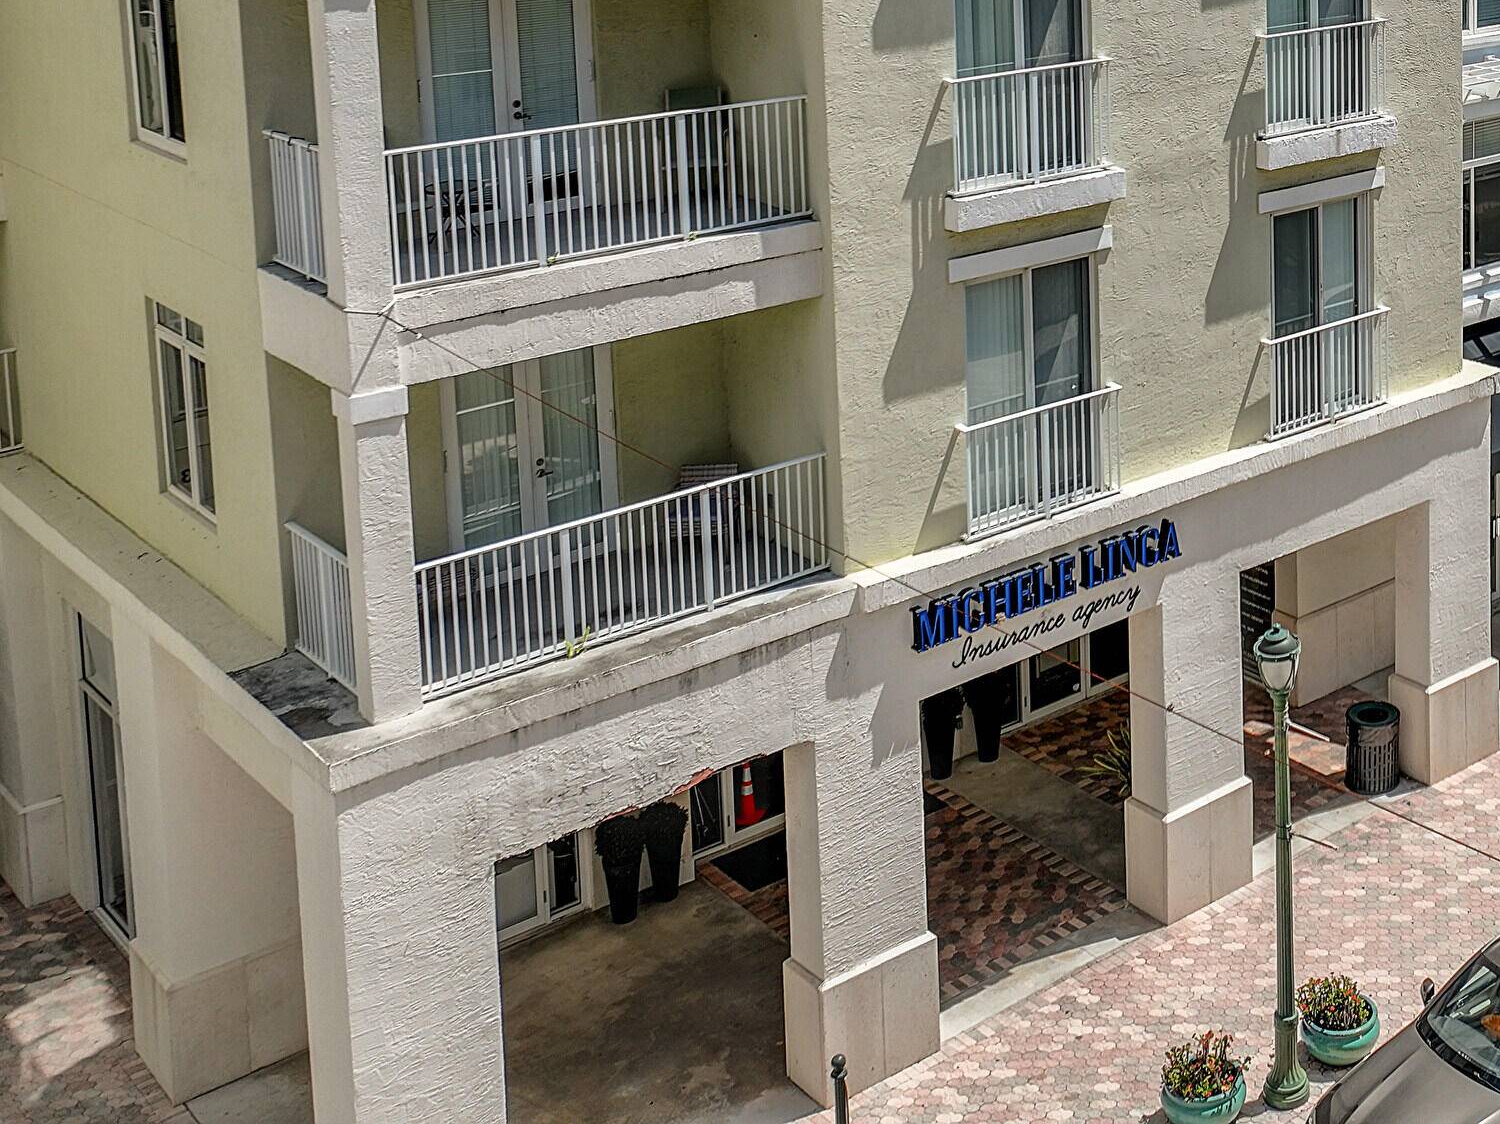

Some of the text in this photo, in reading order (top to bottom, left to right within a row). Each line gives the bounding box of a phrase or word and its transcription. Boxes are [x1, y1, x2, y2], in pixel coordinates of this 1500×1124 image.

[909, 552, 1077, 654] MICHELE
[952, 585, 1141, 669] Insurance agency
